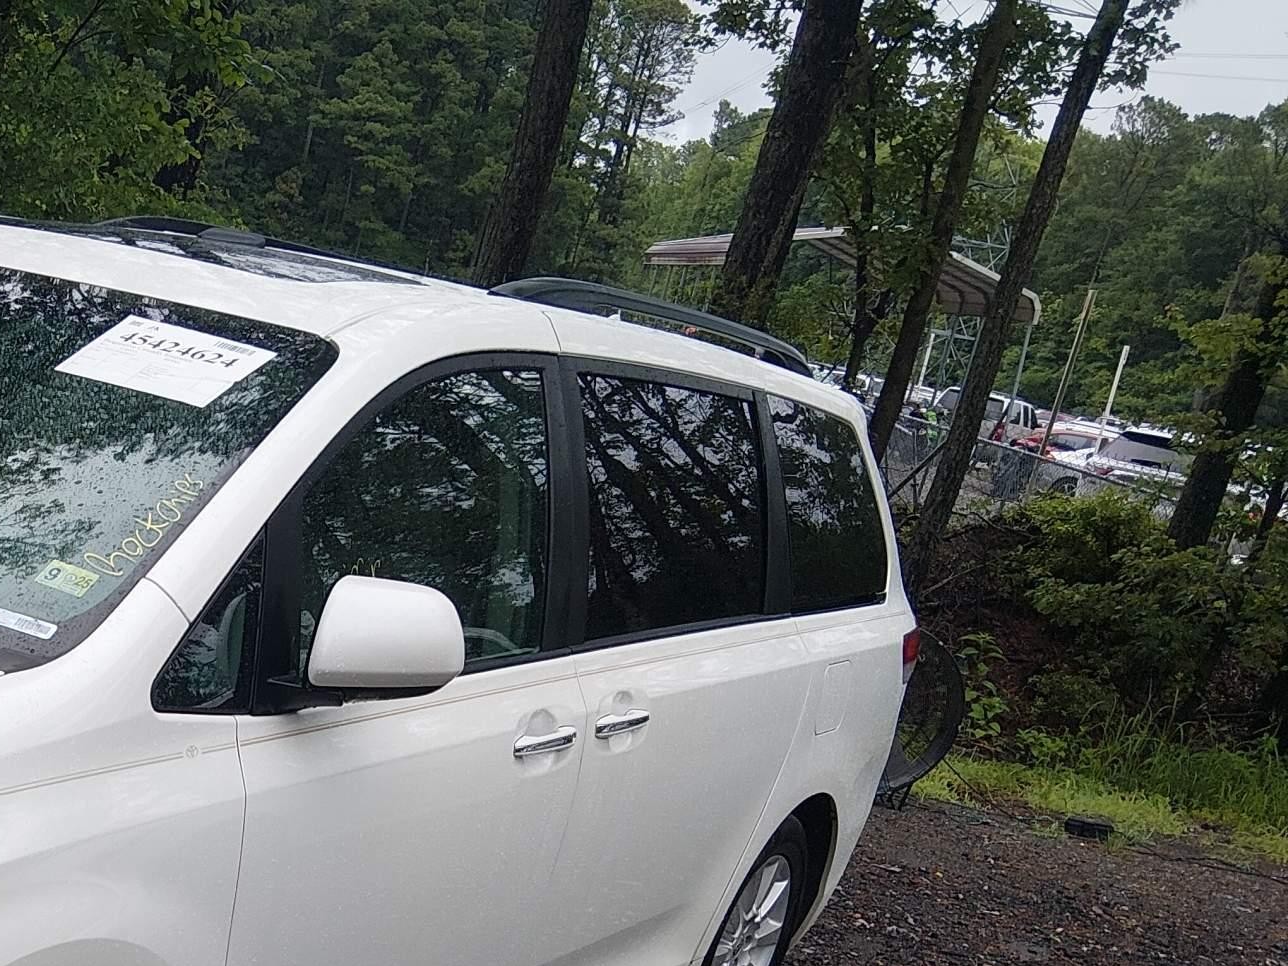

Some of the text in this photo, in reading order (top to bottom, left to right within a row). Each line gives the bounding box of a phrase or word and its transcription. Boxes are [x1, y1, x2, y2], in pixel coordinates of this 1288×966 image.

[119, 331, 240, 369] 45424624
[43, 567, 93, 590] 9 25
